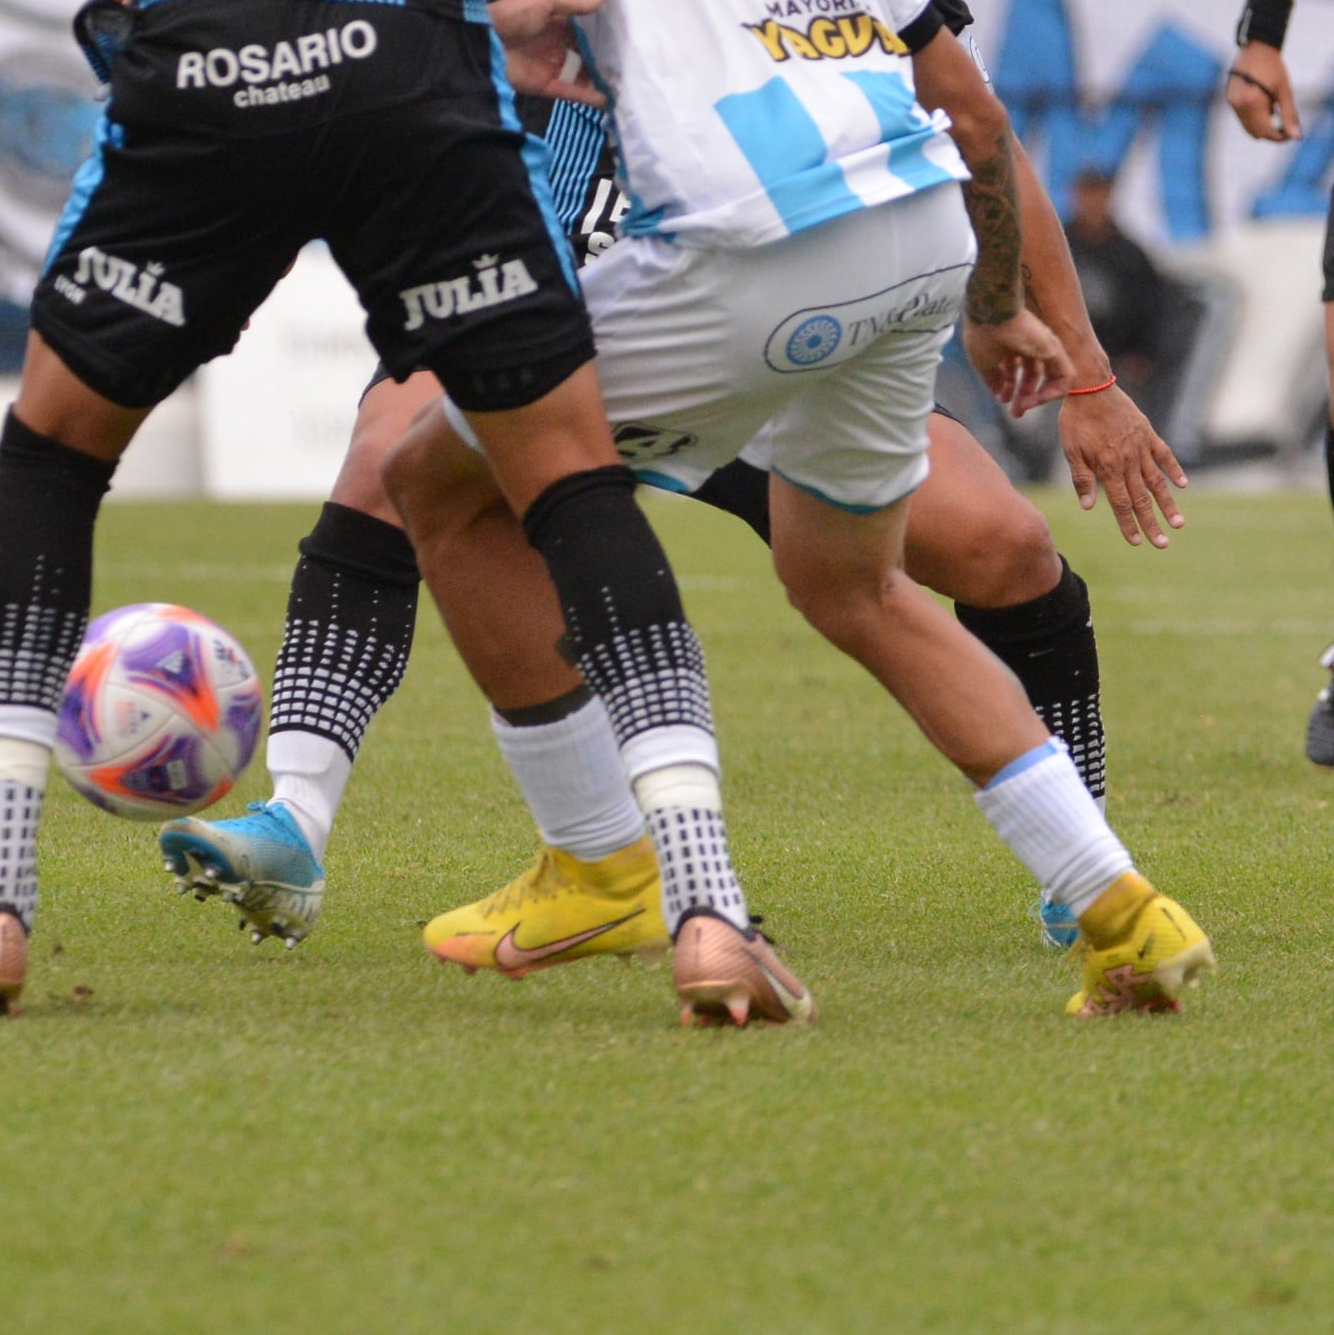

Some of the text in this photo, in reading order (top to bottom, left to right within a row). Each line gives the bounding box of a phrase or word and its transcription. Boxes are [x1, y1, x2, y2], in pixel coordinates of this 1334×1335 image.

[177, 19, 378, 90] ROSARIO
[741, 12, 911, 63] YAGUA
[233, 74, 331, 108] chateau
